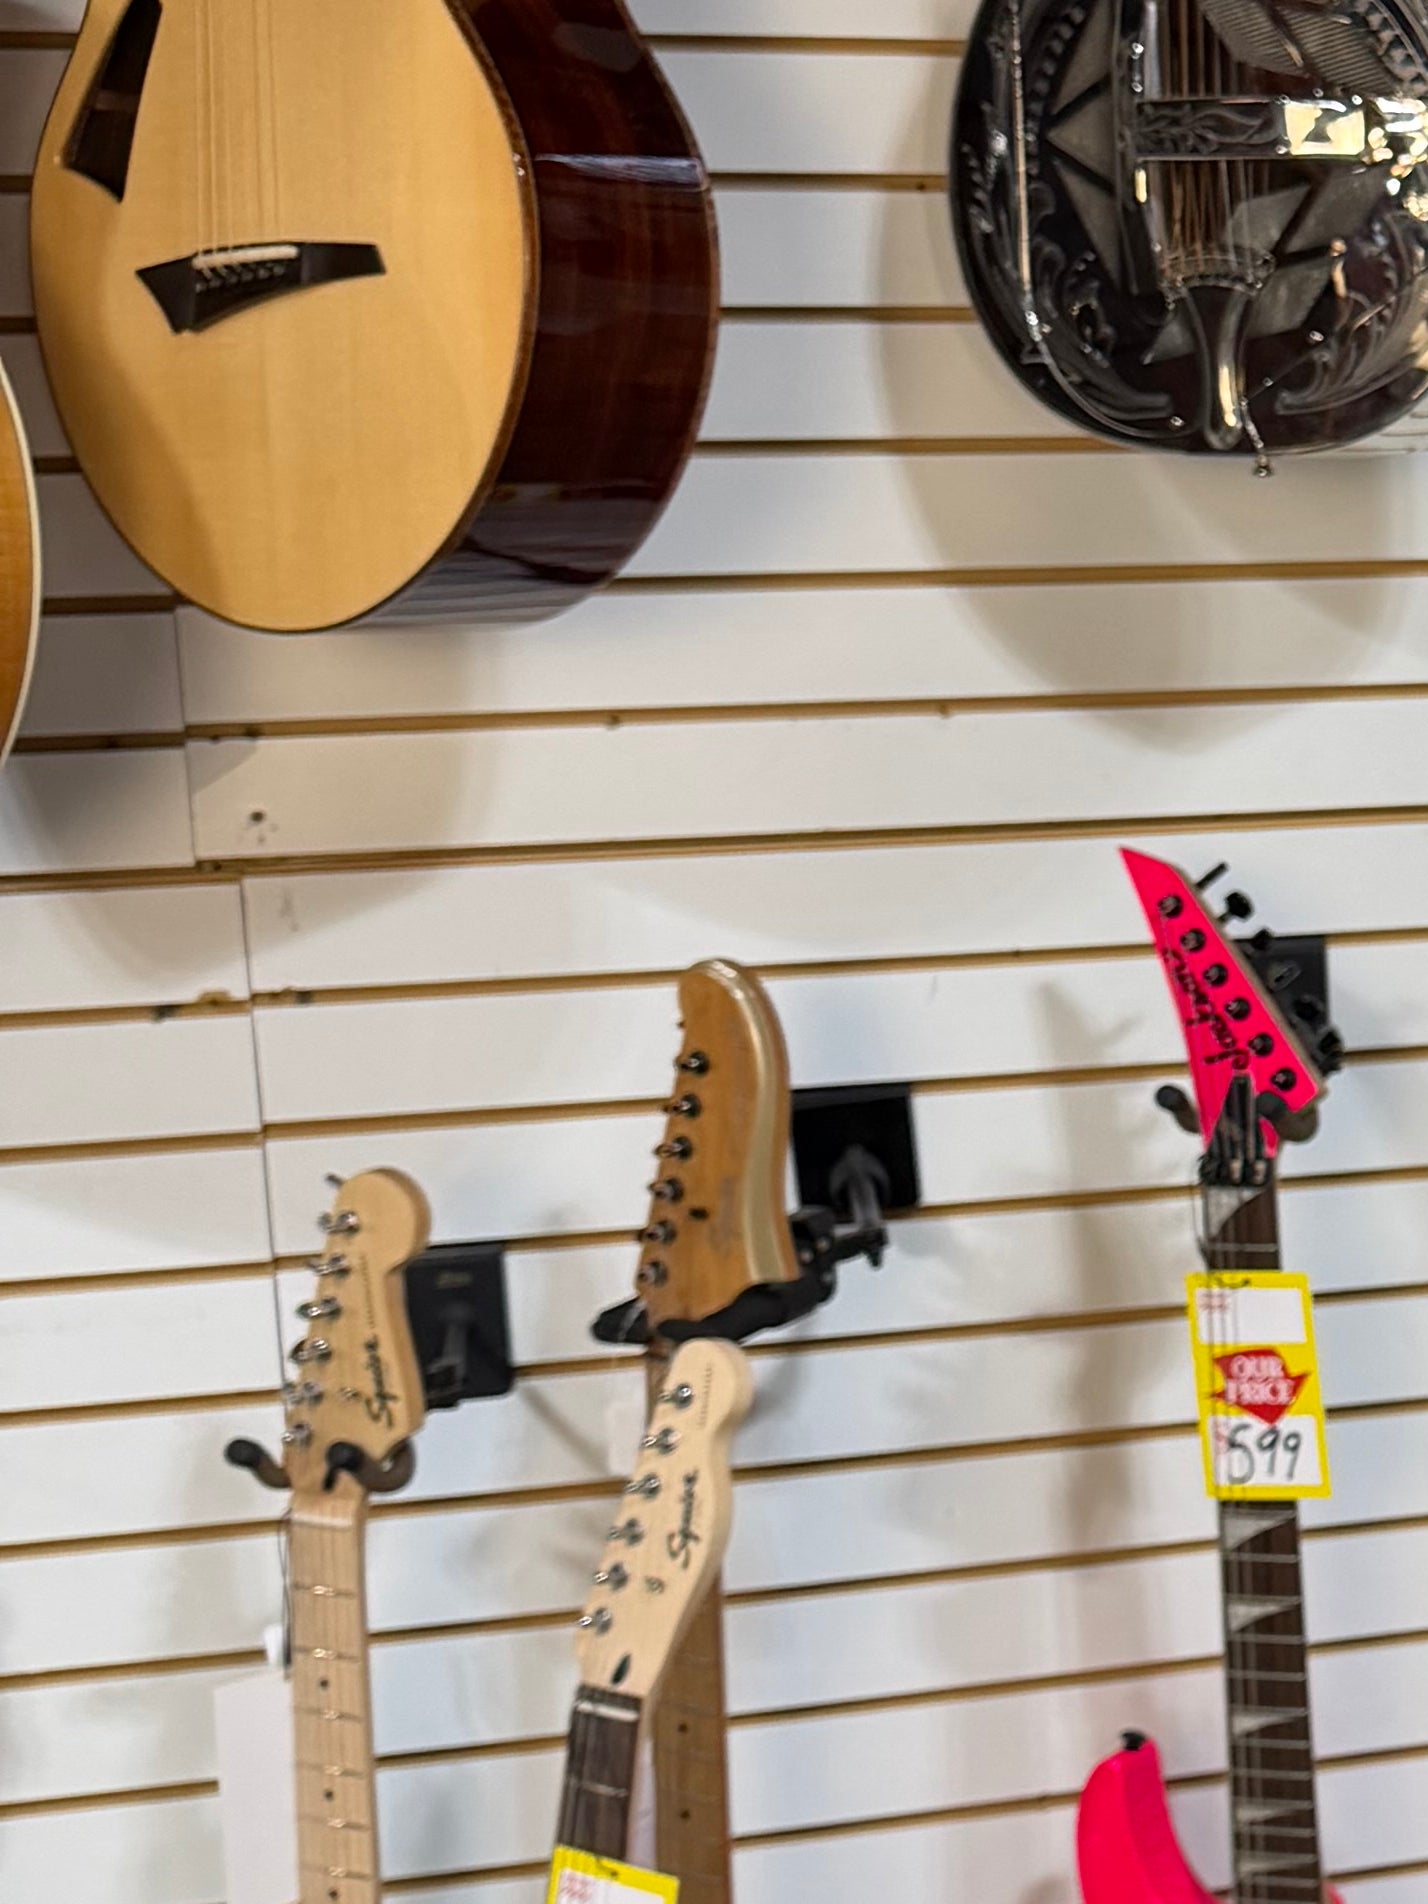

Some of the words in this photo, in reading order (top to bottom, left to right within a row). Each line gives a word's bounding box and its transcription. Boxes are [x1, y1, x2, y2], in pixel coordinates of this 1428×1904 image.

[1229, 1354, 1285, 1379] OUR
[1224, 1376, 1295, 1406] PRICE
[666, 1468, 700, 1570] Squier
